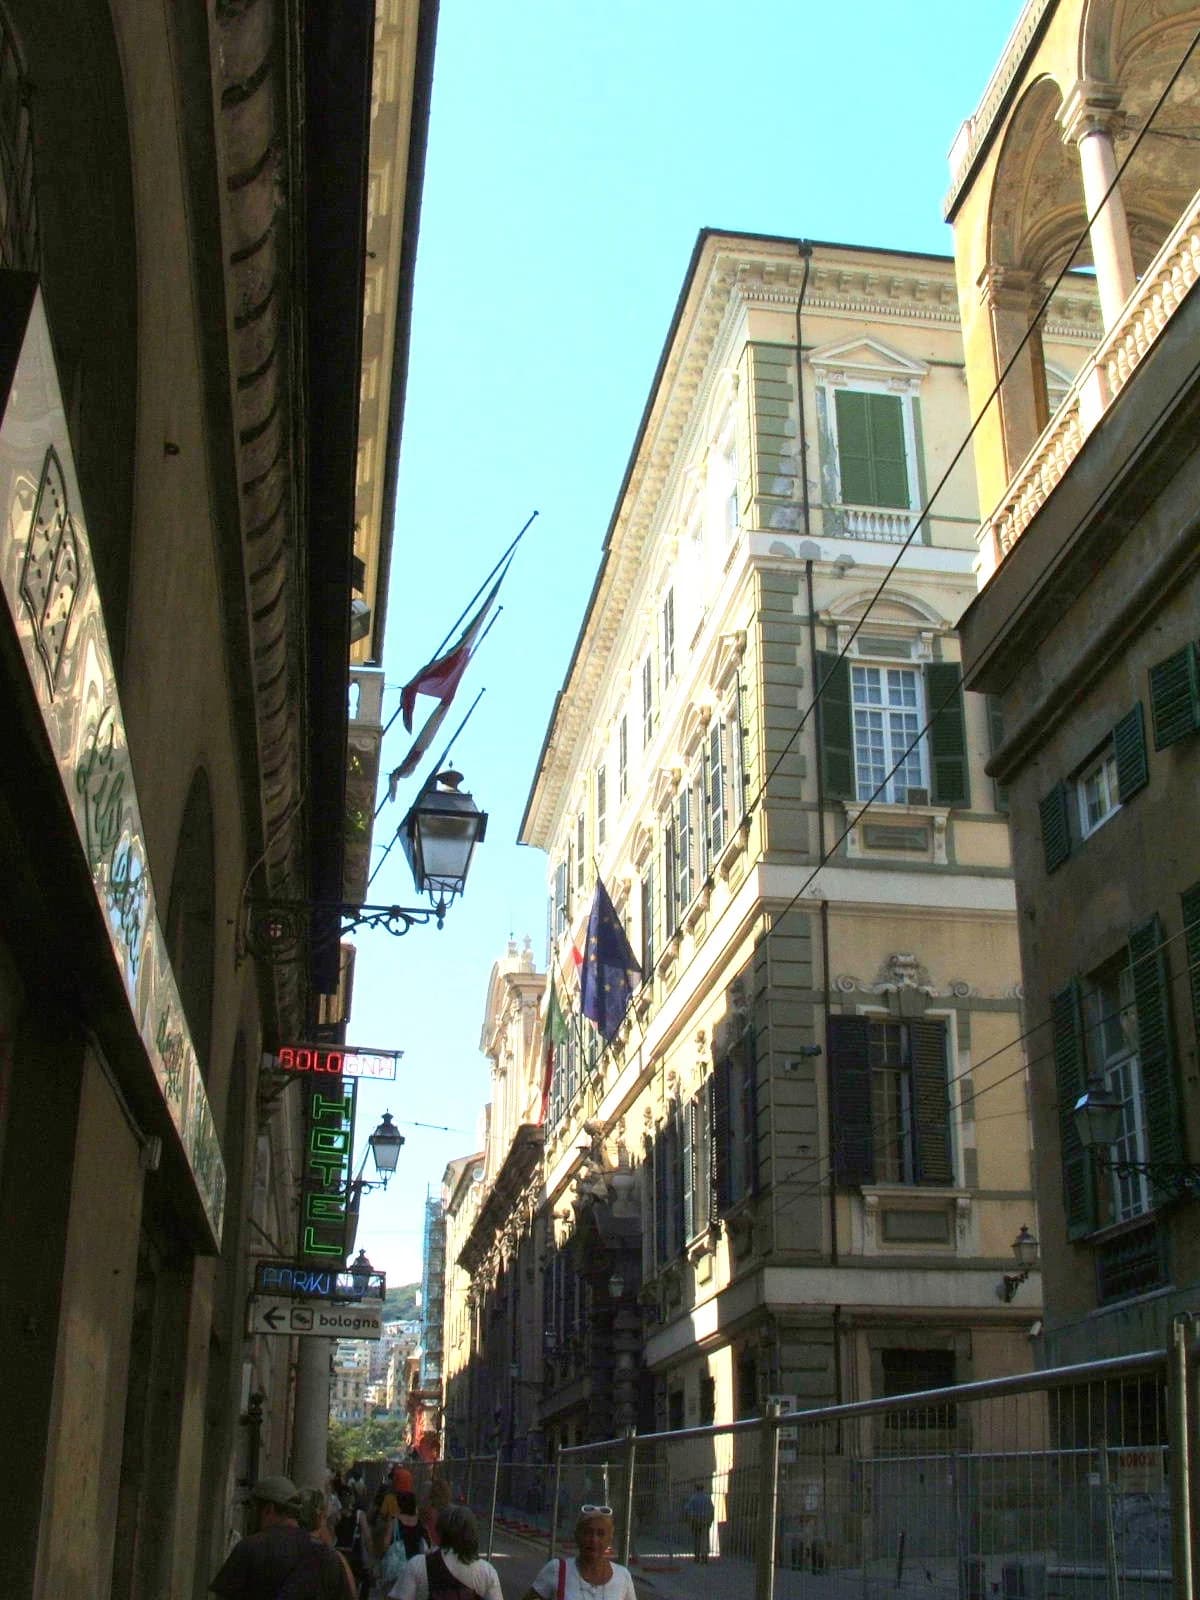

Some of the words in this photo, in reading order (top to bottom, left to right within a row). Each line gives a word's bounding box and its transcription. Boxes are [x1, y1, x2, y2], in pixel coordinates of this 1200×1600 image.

[279, 1048, 393, 1077] BOLOGNA
[303, 1094, 351, 1256] HOTEL
[319, 1314, 380, 1330] bologna
